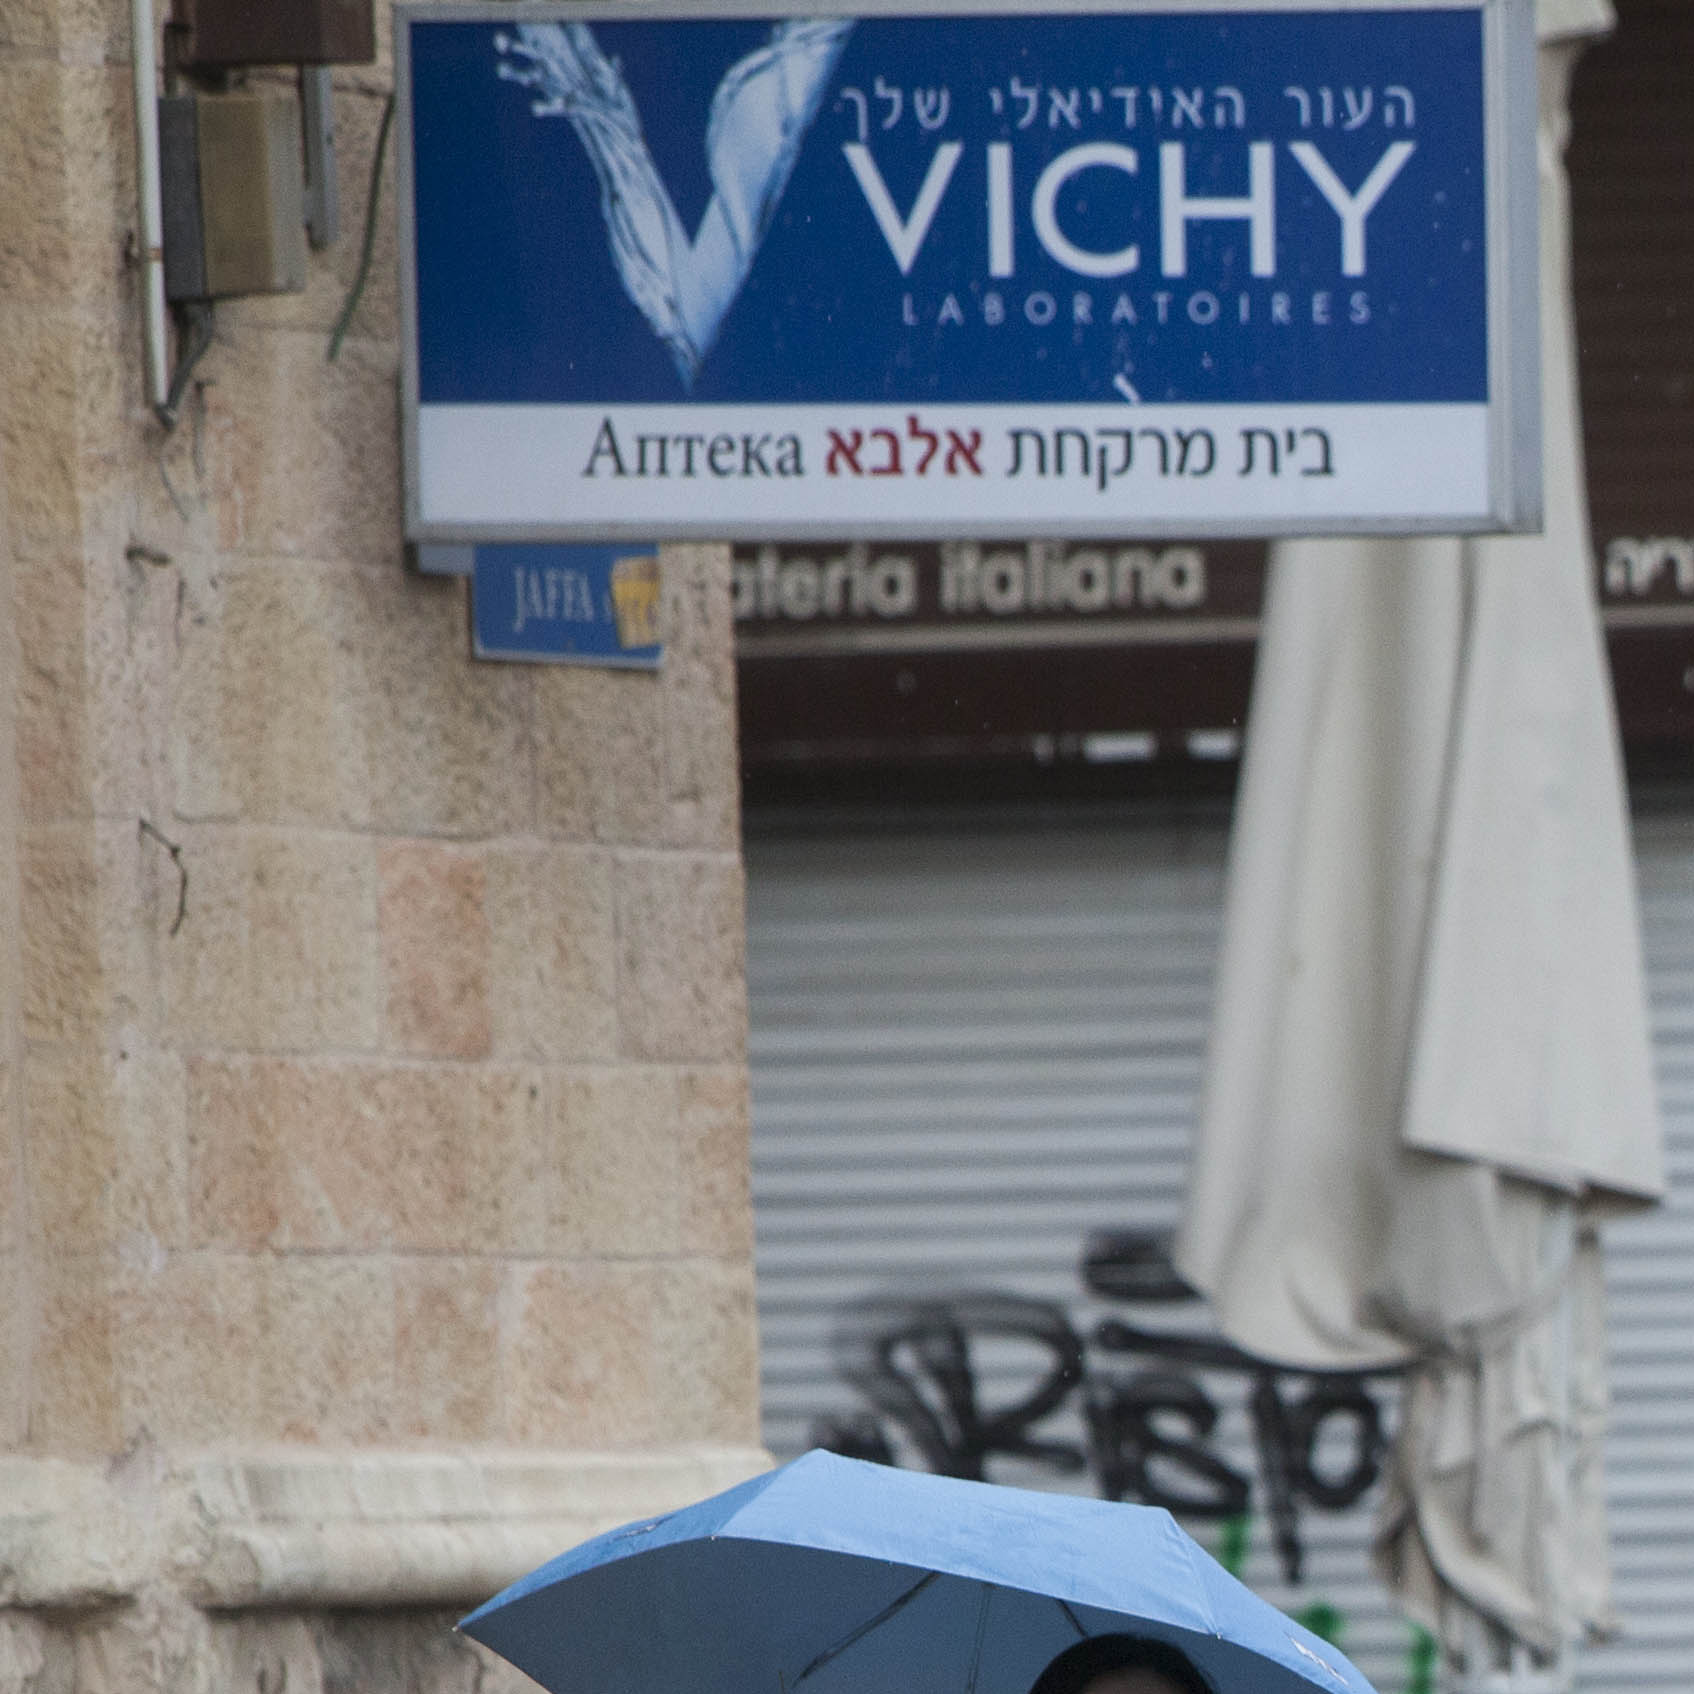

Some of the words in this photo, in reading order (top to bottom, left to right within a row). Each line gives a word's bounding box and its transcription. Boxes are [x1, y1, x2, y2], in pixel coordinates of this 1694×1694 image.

[840, 76, 951, 141] שלך
[989, 75, 1247, 129] האידיאלי
[1284, 84, 1417, 130] העור
[841, 140, 1417, 278] VICHY
[902, 291, 1371, 326] LABORATOIRES
[582, 416, 804, 479] Аптека
[825, 414, 985, 478] אלבא
[1006, 426, 1217, 493] מרקחת
[1238, 426, 1337, 478] בית
